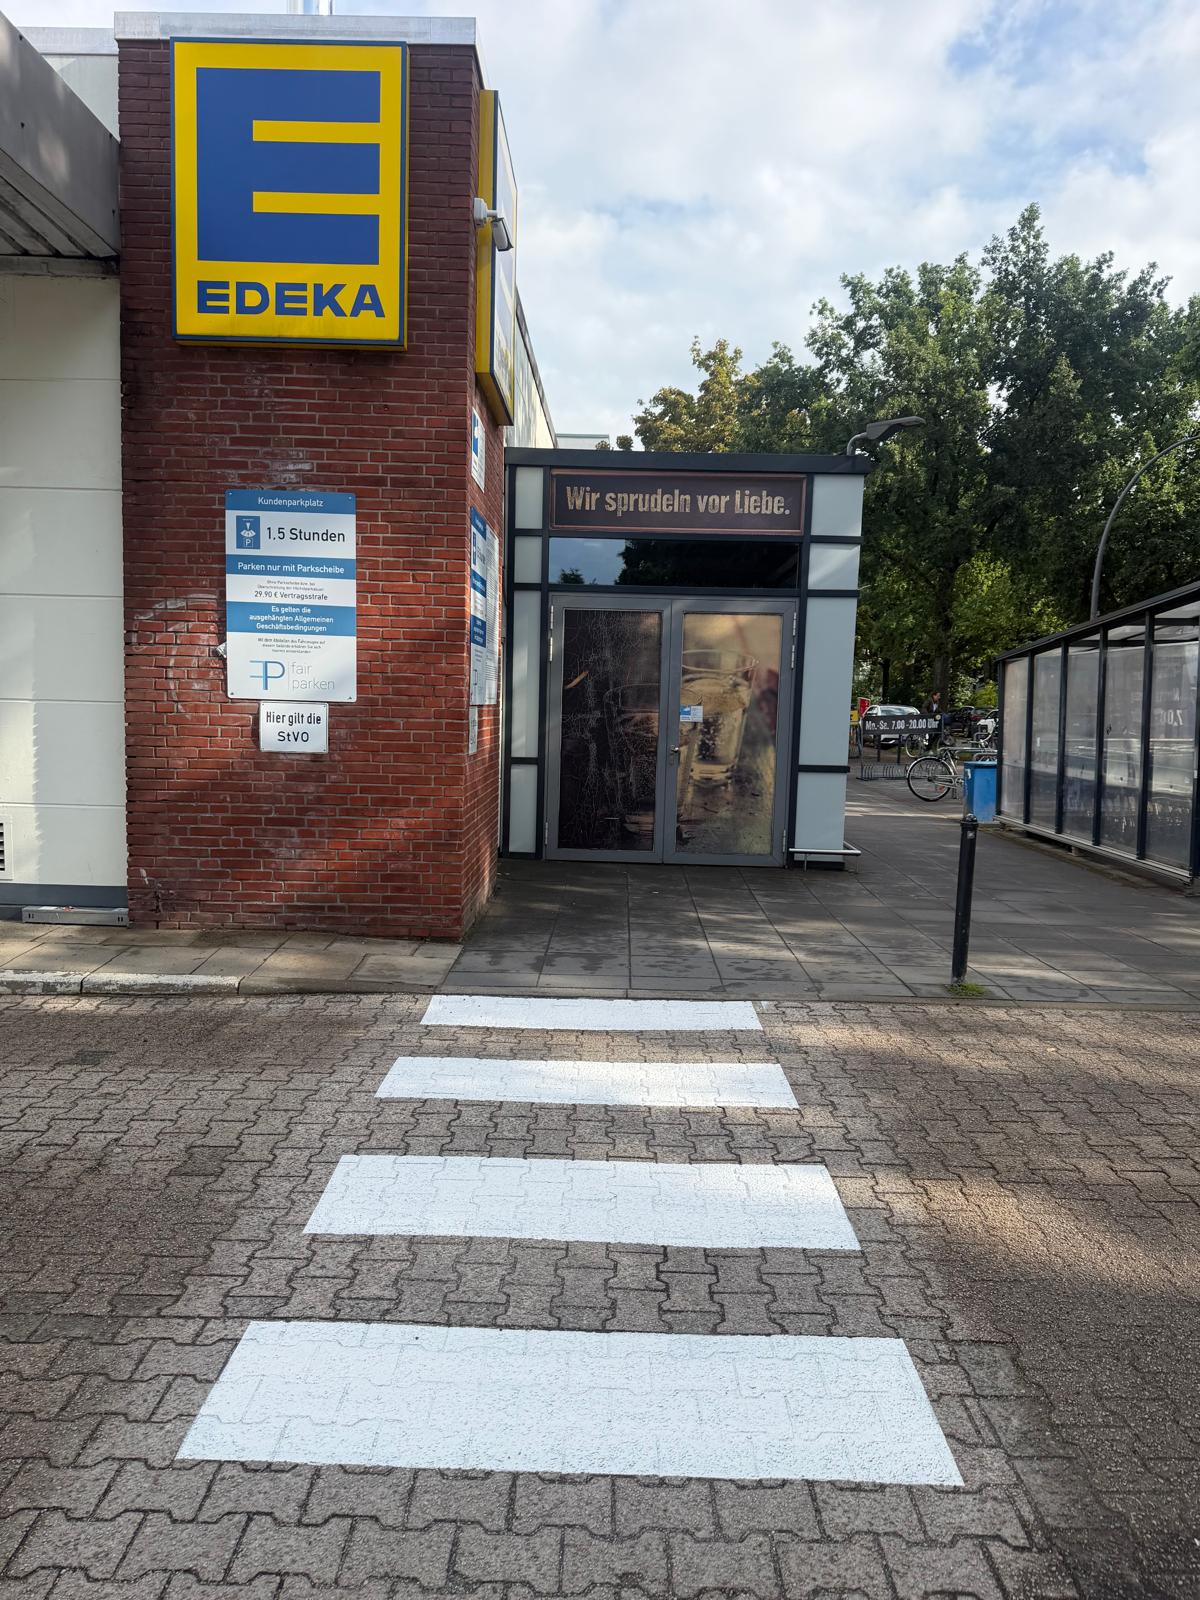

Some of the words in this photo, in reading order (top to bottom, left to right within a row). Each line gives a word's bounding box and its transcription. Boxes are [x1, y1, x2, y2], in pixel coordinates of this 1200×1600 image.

[196, 67, 381, 265] E
[197, 279, 385, 318] EDEKA
[258, 497, 324, 507] Kundenparkplatz
[566, 486, 600, 511] Wir
[605, 488, 690, 517] sprudeln
[697, 494, 729, 513] vor
[735, 490, 790, 515] Liebe.
[290, 528, 345, 542] Stunden
[238, 562, 265, 571] Parken
[283, 563, 295, 572] mit
[297, 564, 345, 574] Parkscheibe
[280, 592, 328, 600] Vertragsstrafe
[281, 606, 300, 614] gelten
[250, 615, 293, 624] ausgehängten
[294, 616, 334, 624] Allgemeinen
[256, 623, 327, 632] Geschäftsbedingungen
[292, 662, 312, 675] fair
[292, 678, 335, 690] parken
[266, 712, 286, 723] Hier
[288, 712, 304, 726] gilt
[307, 713, 321, 724] die
[928, 719, 939, 729] Uhr
[278, 731, 310, 742] StVO
